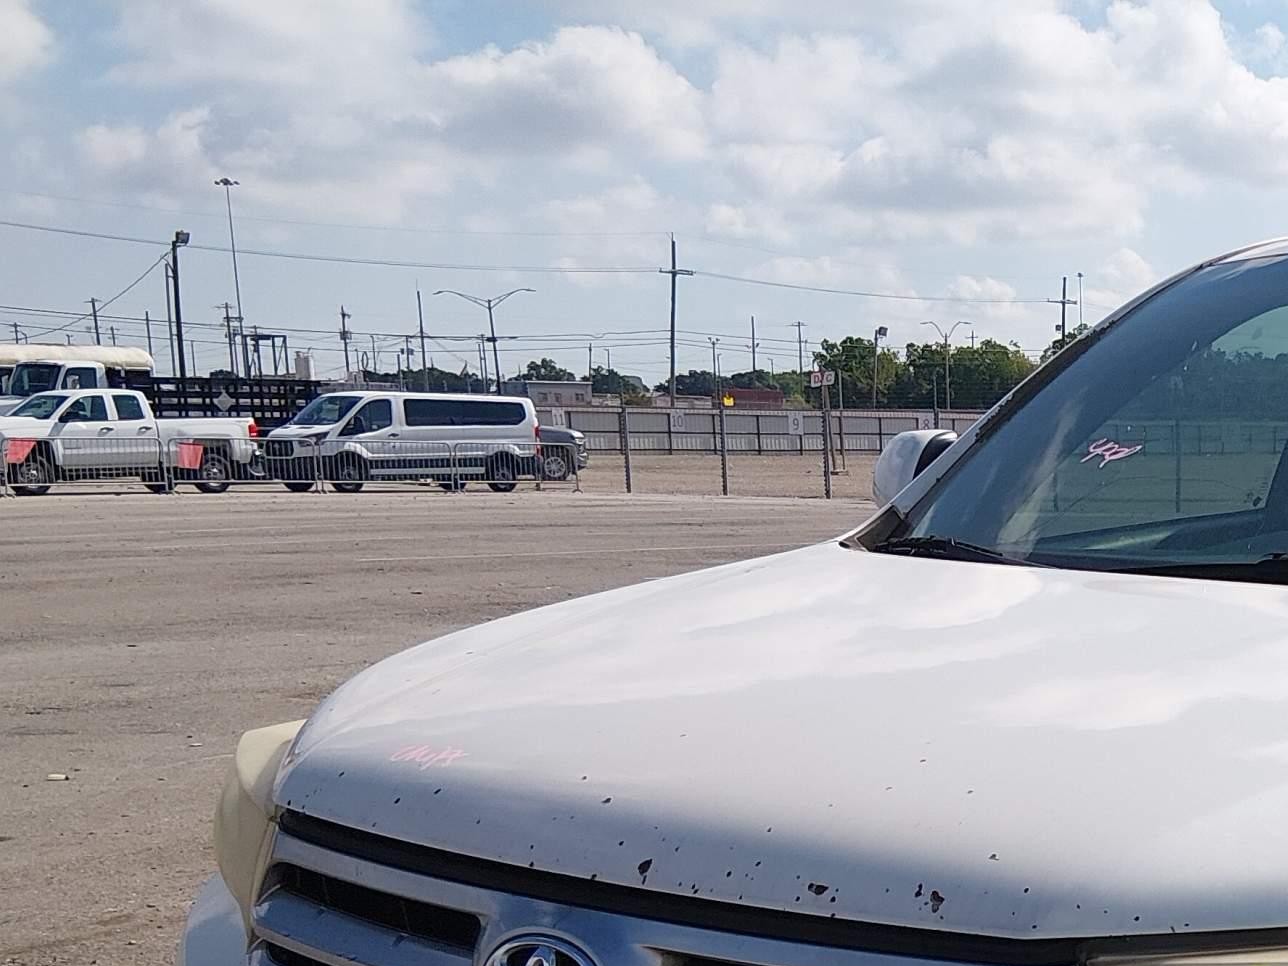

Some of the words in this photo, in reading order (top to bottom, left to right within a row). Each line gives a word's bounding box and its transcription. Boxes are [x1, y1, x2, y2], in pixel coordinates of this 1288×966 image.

[813, 374, 820, 384] D
[671, 415, 684, 428] 10
[792, 417, 800, 430] 9
[923, 418, 930, 430] 8
